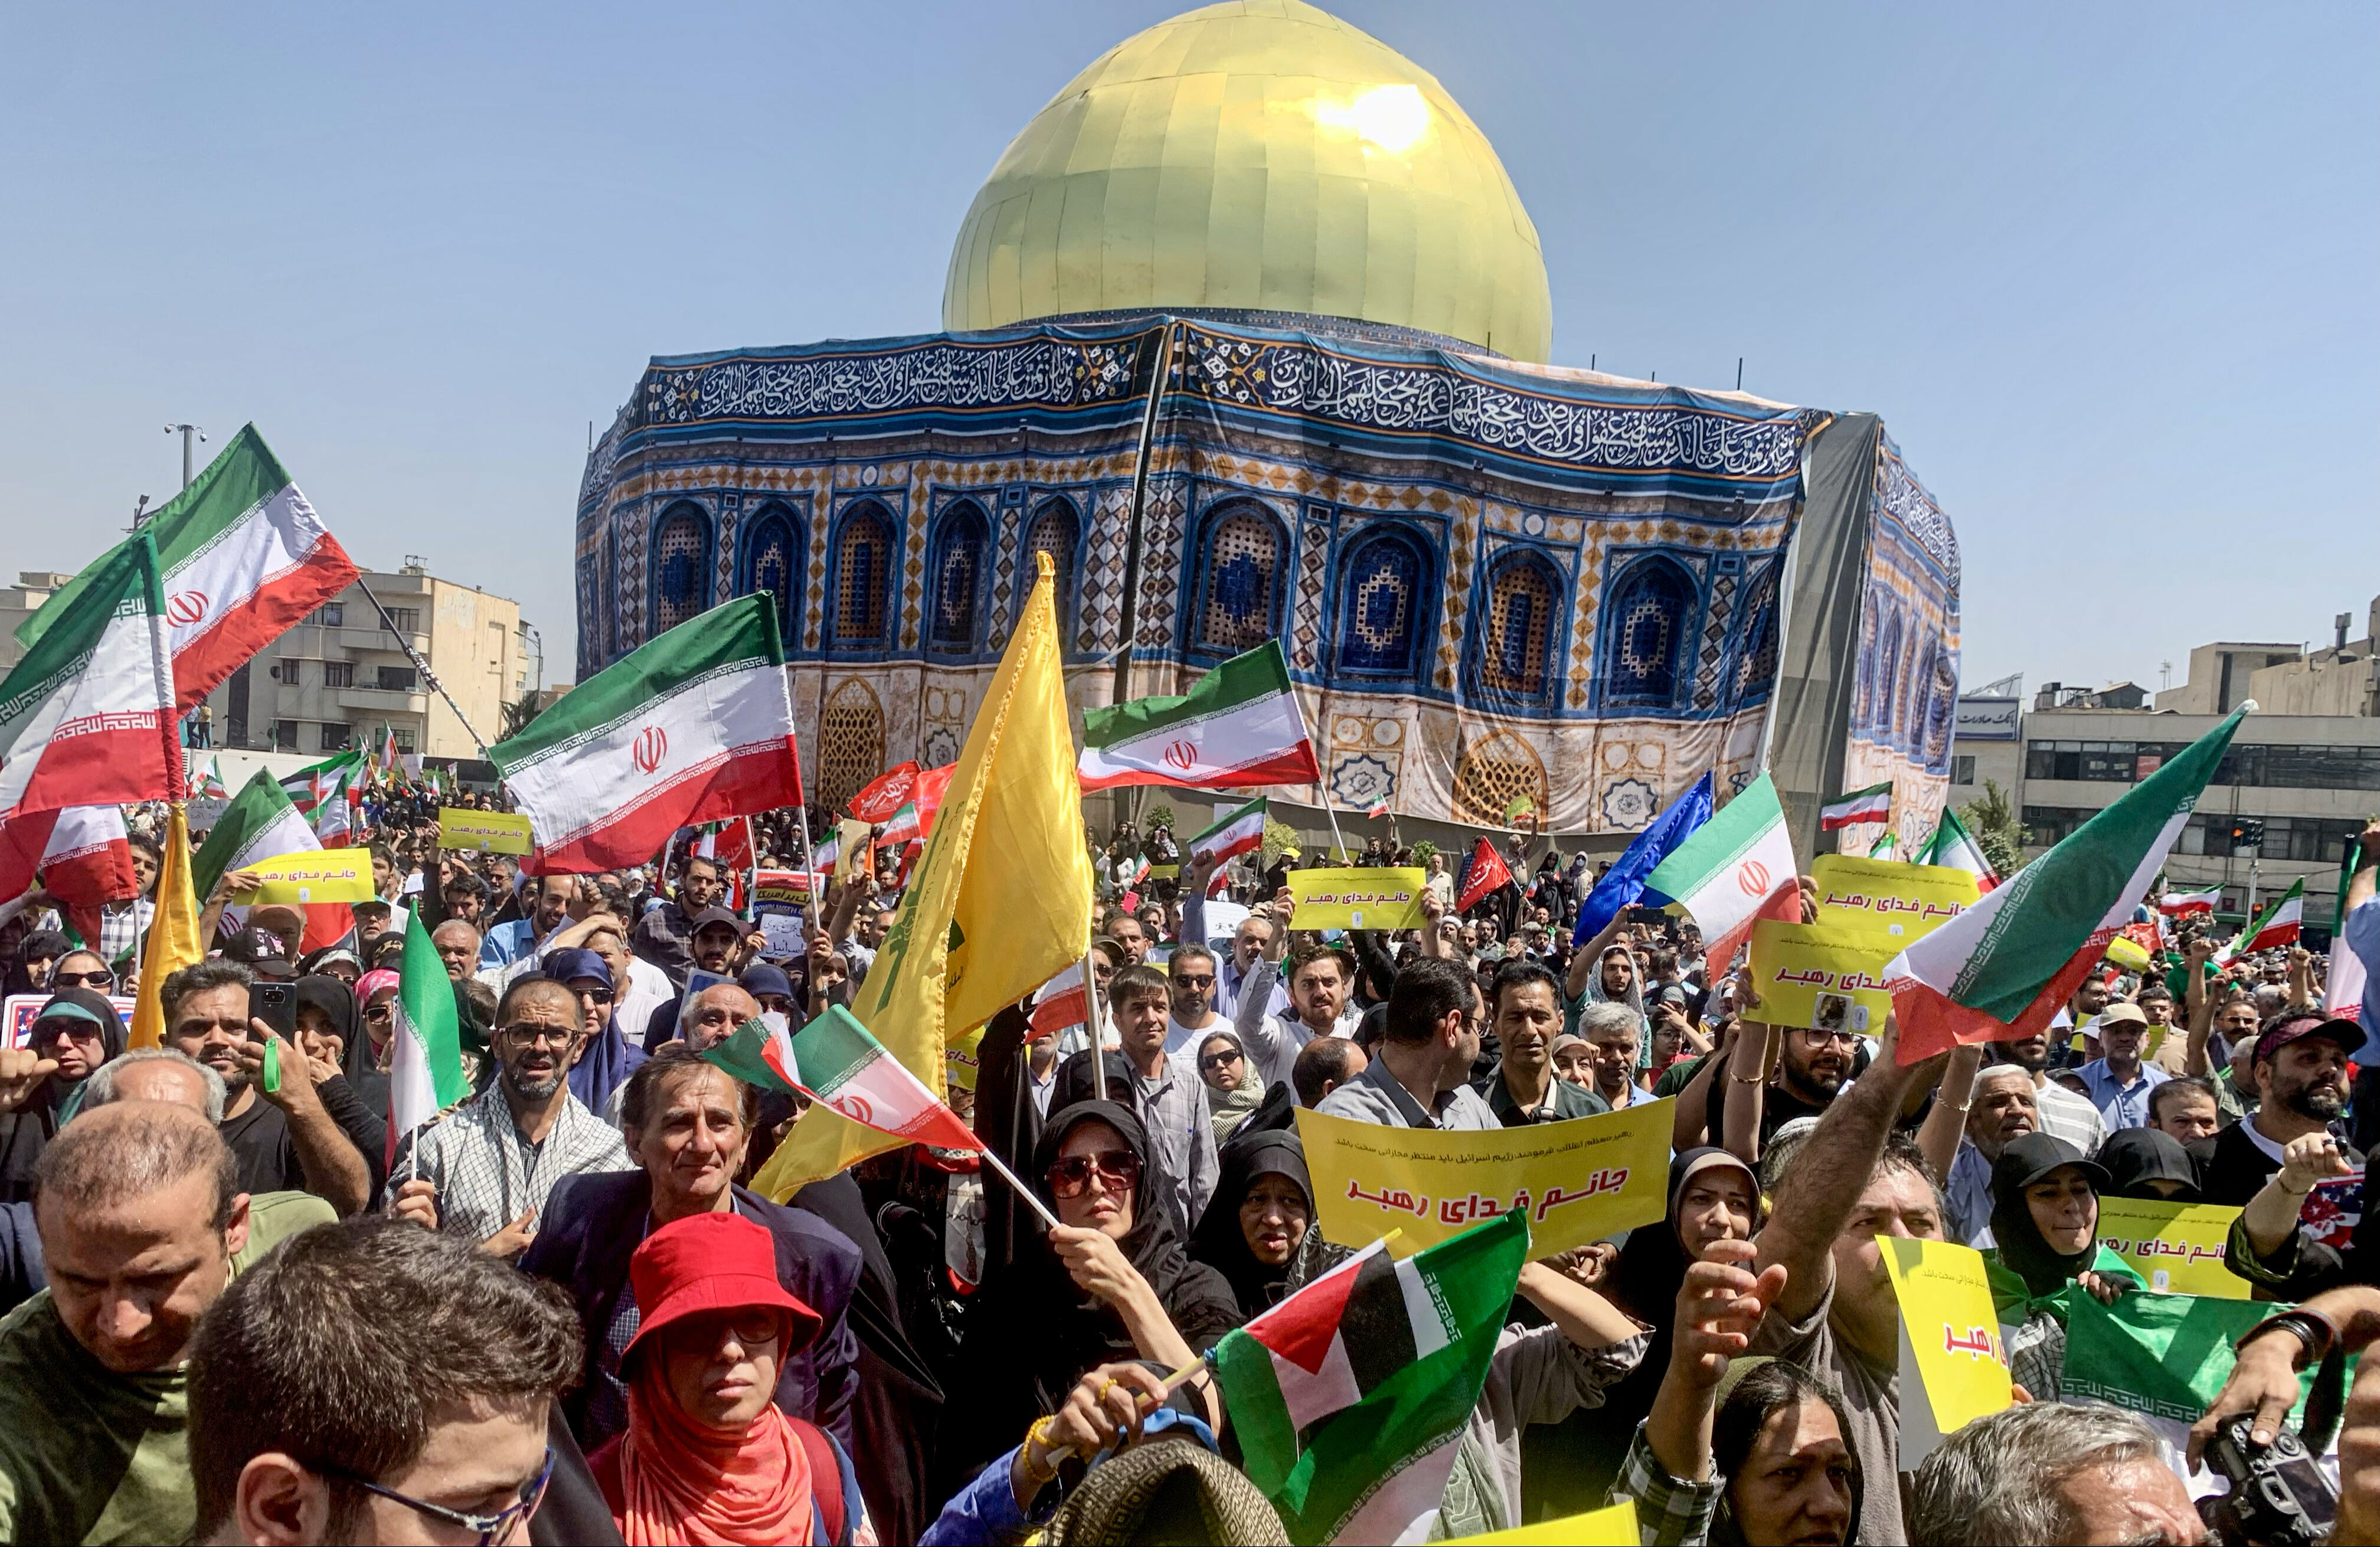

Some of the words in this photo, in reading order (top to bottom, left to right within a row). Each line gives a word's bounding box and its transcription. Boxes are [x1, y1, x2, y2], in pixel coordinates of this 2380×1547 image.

[260, 872, 284, 882] رهب
[288, 870, 319, 881] فدای
[323, 869, 355, 882] جانم
[1305, 893, 1338, 904] رهبر
[1342, 892, 1373, 904] فدای
[1376, 892, 1410, 907] جانم
[1825, 892, 1871, 909] رهبر
[1876, 896, 1920, 912] فدای
[1776, 967, 1835, 987] رهبر
[1347, 1180, 1429, 1216] رهبر
[1536, 1168, 1629, 1221] جانم
[1440, 1190, 1531, 1224] فدای
[2136, 1238, 2186, 1257] فدای
[1946, 1326, 1996, 1359] رهبر
